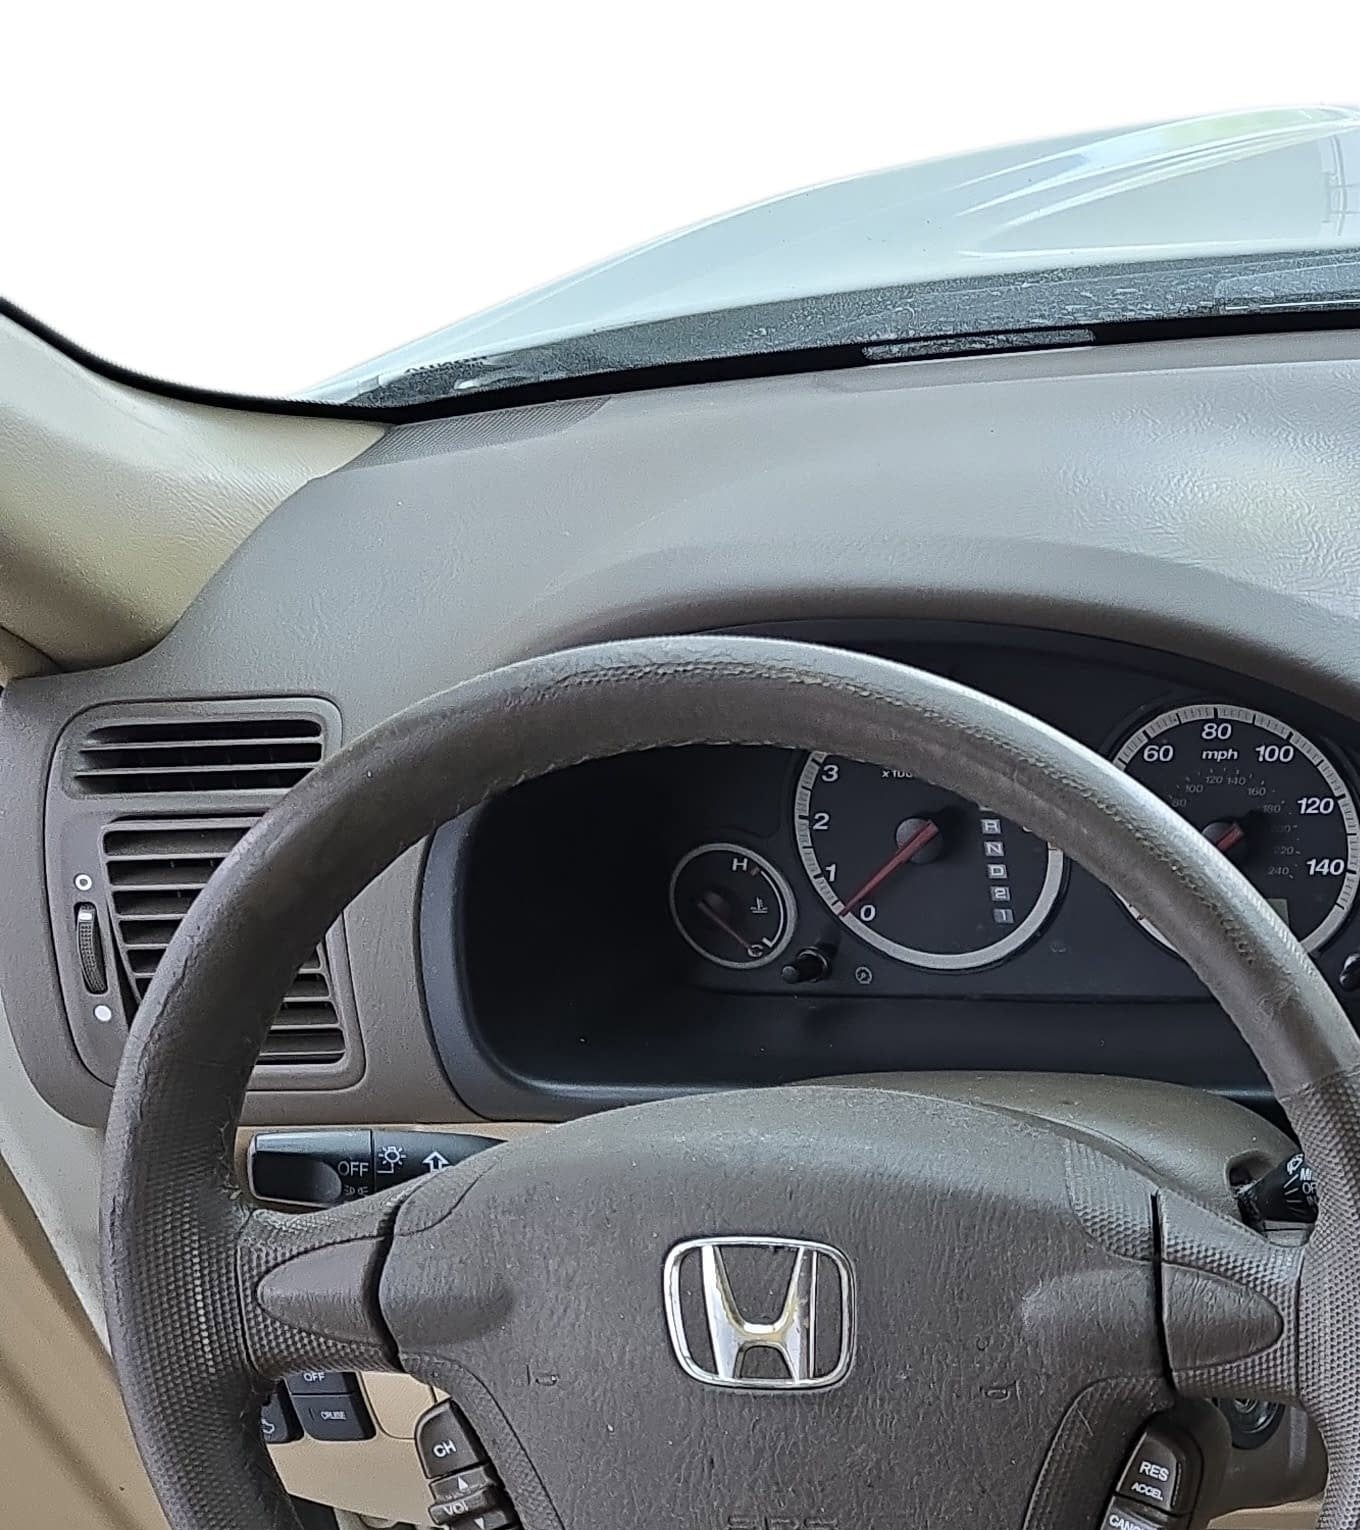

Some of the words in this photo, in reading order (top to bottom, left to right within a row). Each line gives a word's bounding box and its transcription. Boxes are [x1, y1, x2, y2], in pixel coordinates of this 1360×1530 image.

[1202, 723, 1231, 739] 80
[1143, 745, 1173, 762] 60
[1202, 749, 1238, 762] mph
[1256, 745, 1294, 762] 100
[821, 765, 838, 781] 3
[1297, 798, 1334, 814] 120
[813, 814, 829, 830] 2
[987, 843, 1001, 853] N
[732, 858, 748, 872] H
[825, 865, 837, 881] 1
[991, 867, 1003, 876] D
[1307, 859, 1345, 875] 140
[860, 905, 876, 921] 0
[747, 944, 763, 957] C
[338, 1161, 369, 1177] OFF
[303, 1371, 325, 1382] OFF
[433, 1440, 457, 1459] CH
[1139, 1461, 1170, 1482] RES
[1131, 1482, 1164, 1501] ACCEL
